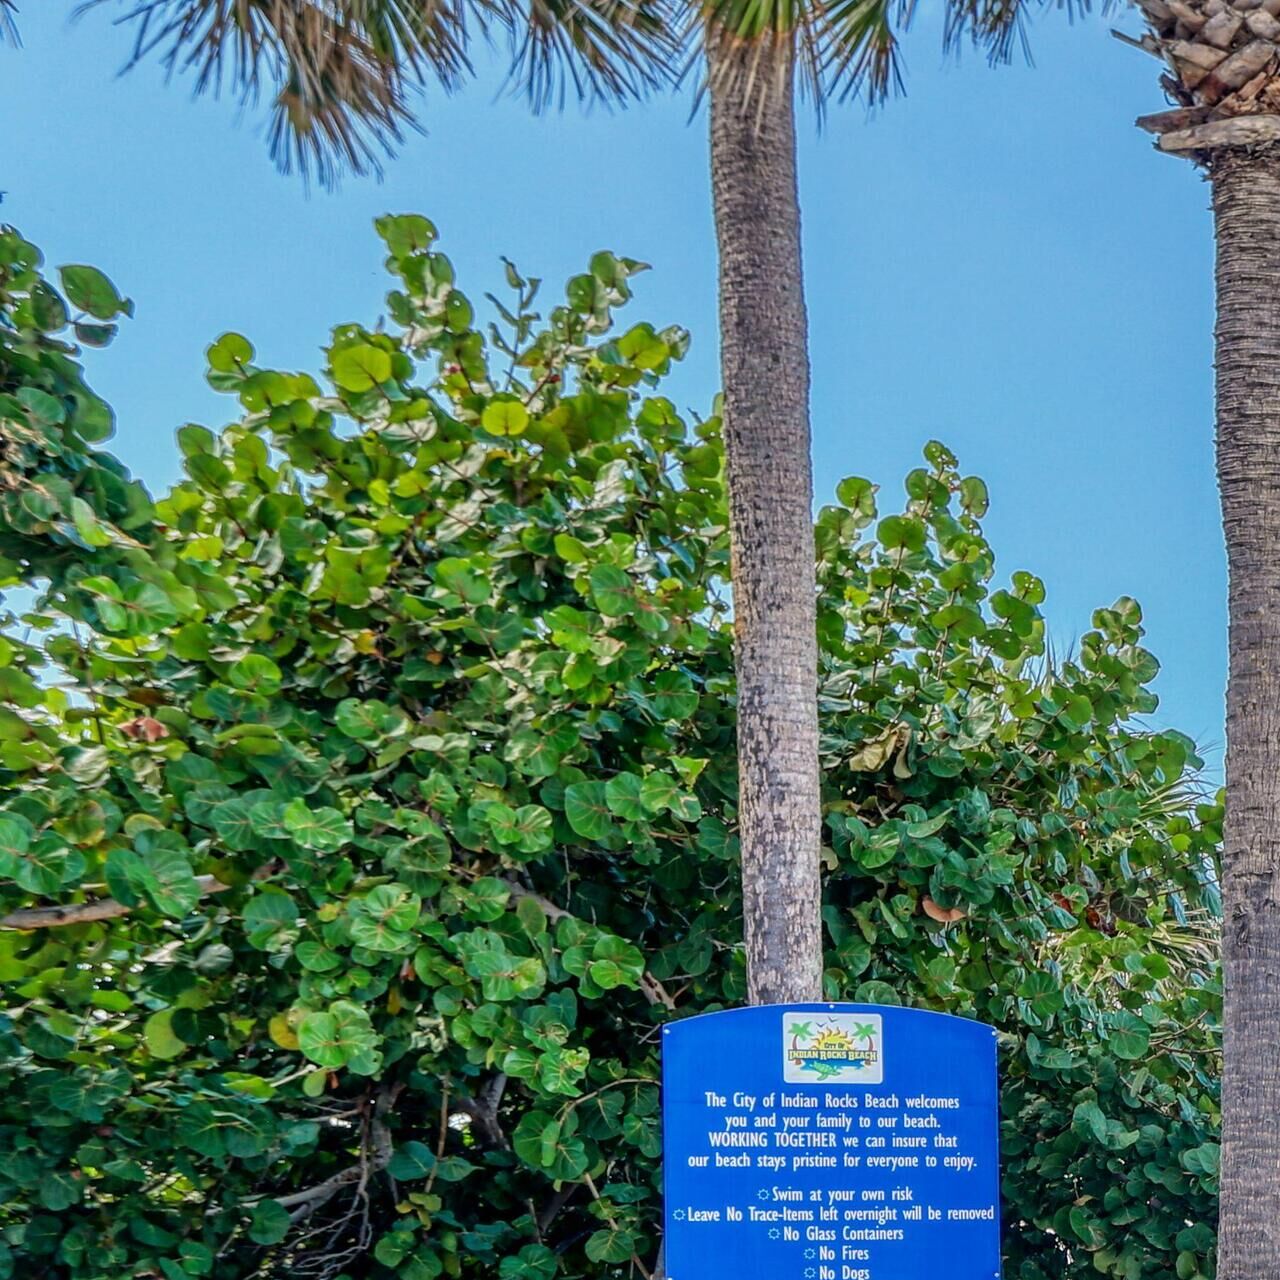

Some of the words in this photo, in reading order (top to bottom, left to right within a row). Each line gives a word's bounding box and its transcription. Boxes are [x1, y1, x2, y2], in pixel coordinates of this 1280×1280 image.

[705, 1092, 726, 1107] The
[734, 1092, 756, 1112] City
[763, 1093, 774, 1107] of
[782, 1093, 818, 1107] Indian
[826, 1094, 858, 1107] Rocks
[866, 1094, 898, 1108] Beach
[906, 1094, 959, 1108] welcomes
[726, 1117, 747, 1132] you
[754, 1113, 776, 1127] and
[783, 1117, 810, 1132] your
[817, 1113, 852, 1132] family
[860, 1117, 870, 1127] to
[878, 1118, 897, 1127] our
[904, 1114, 940, 1128] beach.
[709, 1132, 767, 1146] WORKING
[775, 1132, 836, 1147] TOGETHER
[843, 1137, 858, 1147] we
[866, 1137, 885, 1147] can
[893, 1133, 927, 1147] insure
[934, 1134, 957, 1147] that
[688, 1156, 709, 1166] our
[716, 1152, 750, 1166] beach
[758, 1156, 786, 1171] stays
[793, 1152, 837, 1171] pristine
[844, 1152, 860, 1166] for
[867, 1157, 918, 1171] everyone
[926, 1156, 937, 1166] to
[944, 1153, 976, 1171] enjoy.
[773, 1186, 802, 1201] Swim
[810, 1190, 822, 1201] at
[828, 1191, 855, 1205] your
[862, 1191, 884, 1200] own
[892, 1186, 912, 1200] risk
[688, 1207, 720, 1221] Leave
[727, 1207, 742, 1221] No
[749, 1206, 814, 1221] Trace-Items
[820, 1206, 838, 1220] left
[844, 1206, 897, 1225] overnight
[903, 1206, 922, 1220] will
[928, 1206, 941, 1219] be
[948, 1206, 994, 1219] removed
[784, 1227, 799, 1240] No
[807, 1226, 836, 1240] Glass
[843, 1226, 903, 1240] Containers
[820, 1246, 835, 1260] No
[843, 1246, 869, 1260] Fires
[820, 1266, 835, 1280] No
